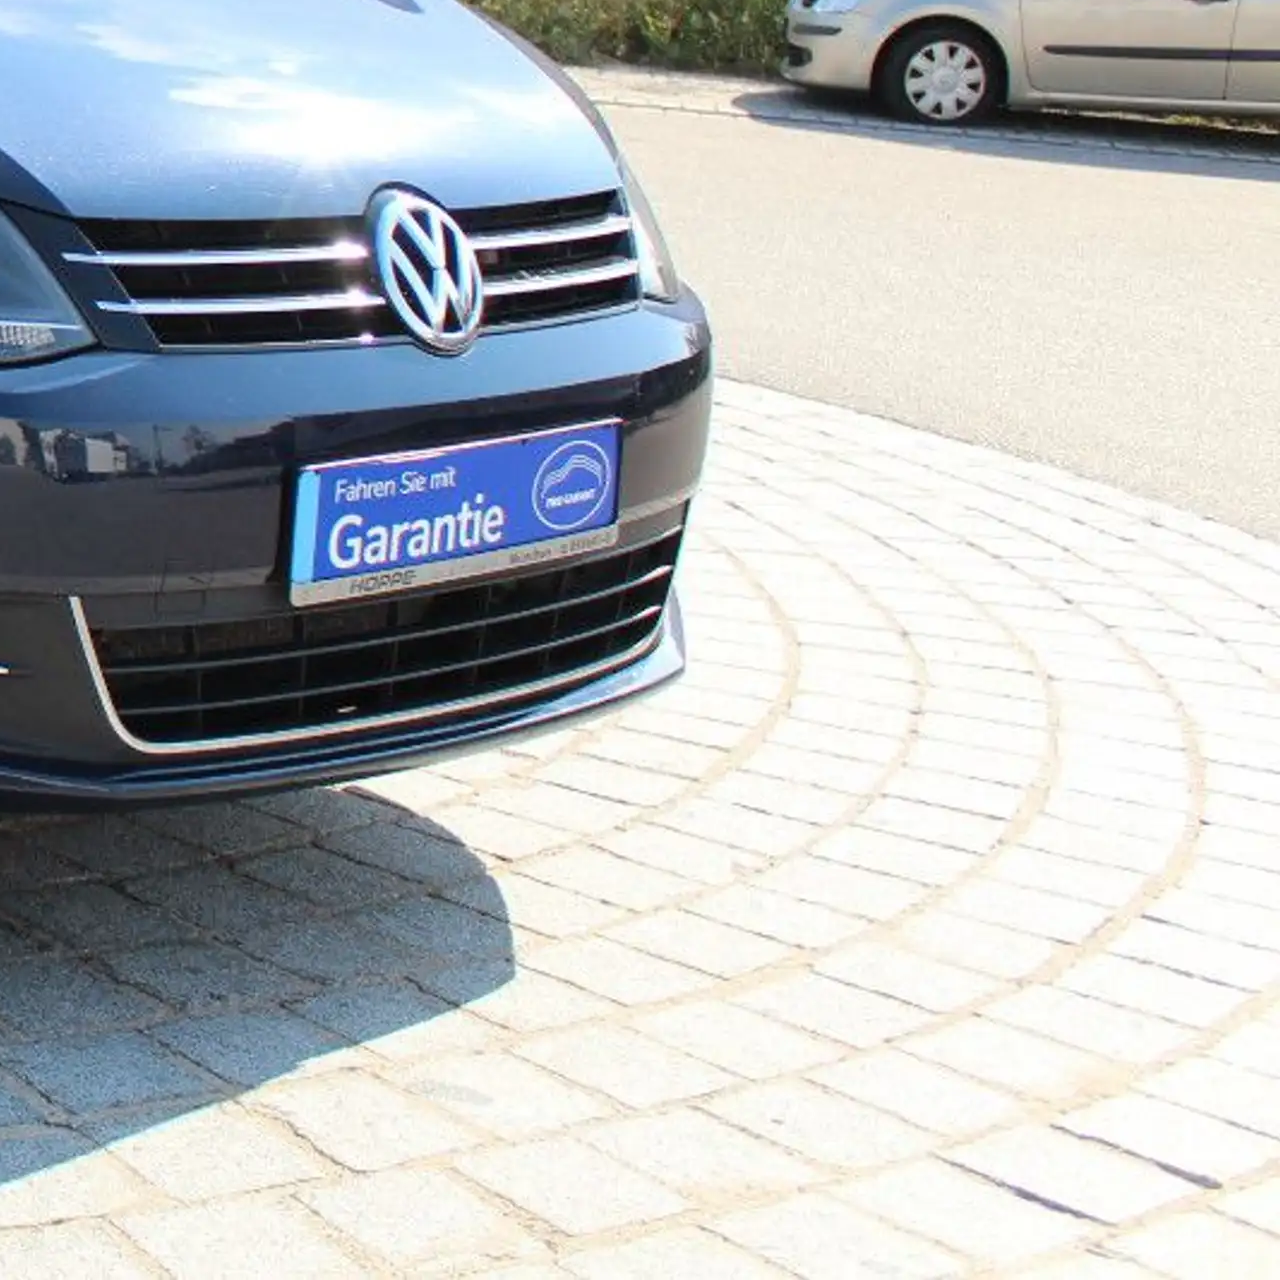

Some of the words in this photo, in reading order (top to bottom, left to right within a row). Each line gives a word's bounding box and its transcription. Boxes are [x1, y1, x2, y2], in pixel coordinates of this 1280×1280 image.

[334, 476, 396, 504] Fahren
[401, 470, 427, 496] Sie
[429, 466, 457, 489] mit
[327, 493, 505, 570] Garantie
